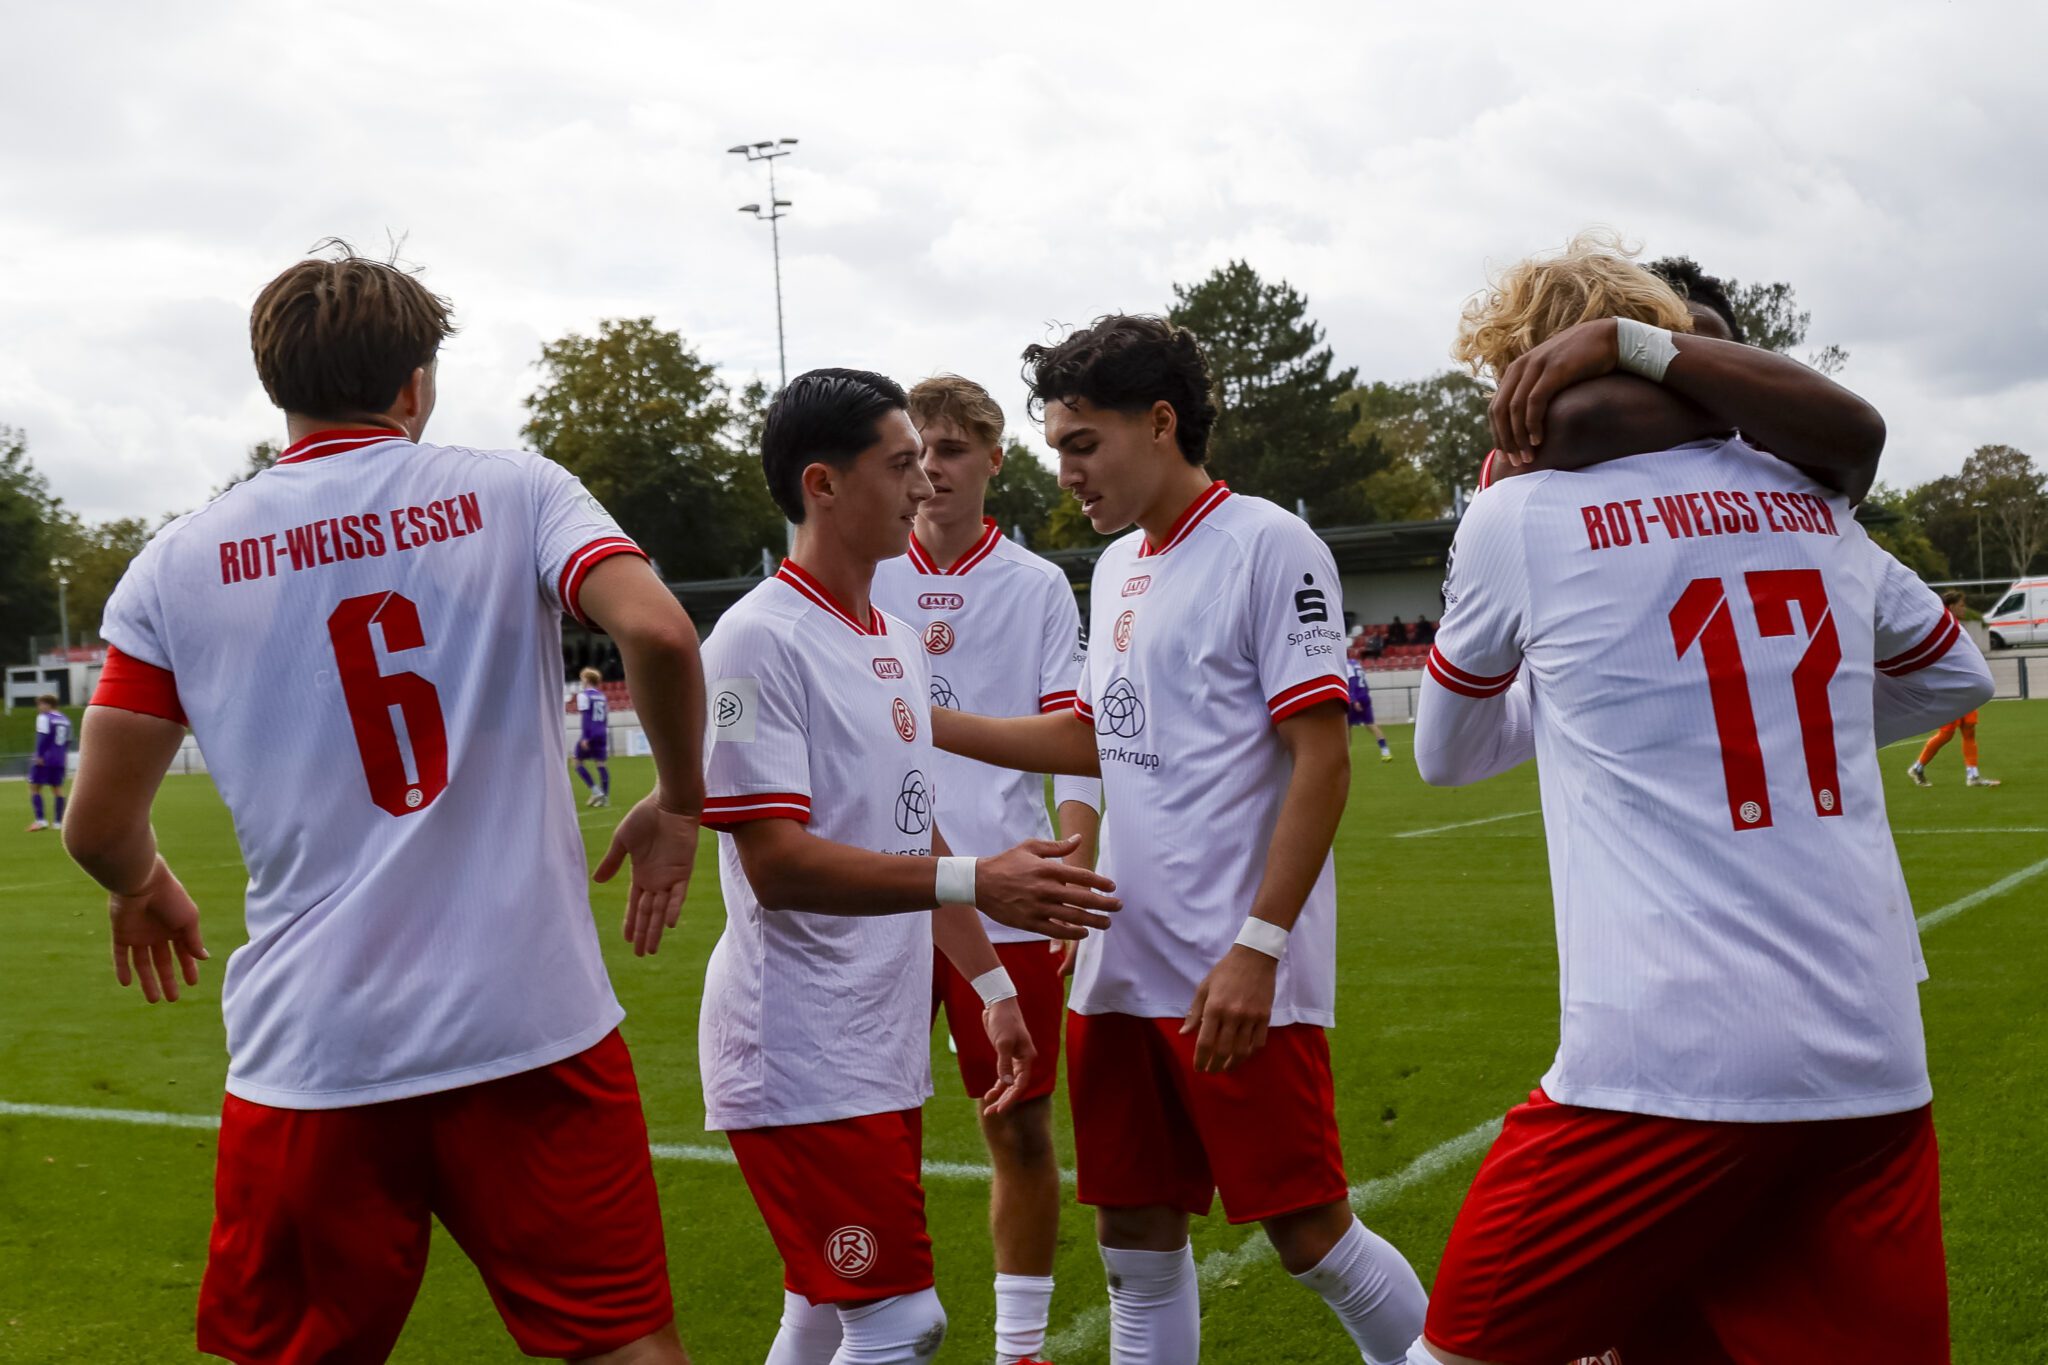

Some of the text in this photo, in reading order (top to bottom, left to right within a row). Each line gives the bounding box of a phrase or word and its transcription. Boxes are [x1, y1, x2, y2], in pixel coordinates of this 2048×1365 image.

[219, 493, 484, 584] ROT-WEISS ESSEN
[1581, 490, 1840, 550] ROT-WEISS ESSEN
[1287, 626, 1342, 646] Sparkasse
[1304, 644, 1333, 657] Esse
[327, 589, 448, 818] 6
[1669, 569, 1843, 832] 17
[1098, 747, 1160, 771] enkrupp
